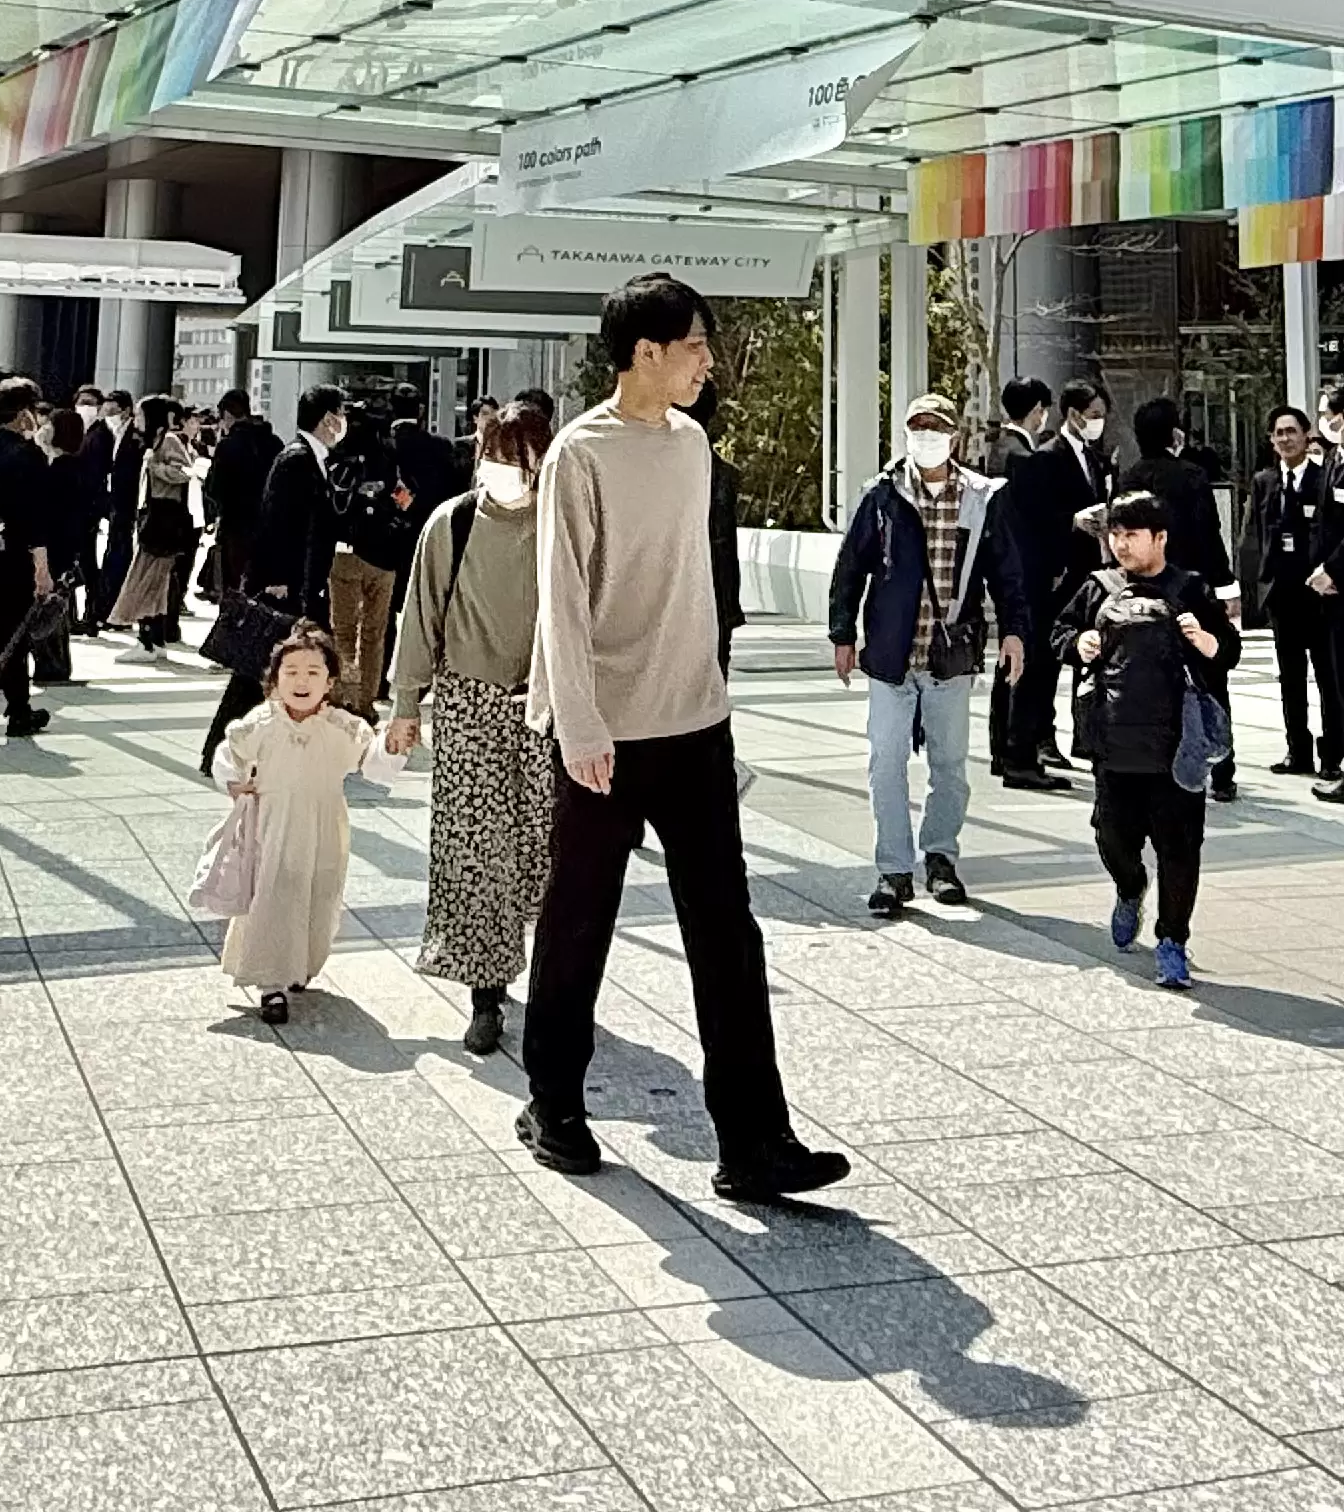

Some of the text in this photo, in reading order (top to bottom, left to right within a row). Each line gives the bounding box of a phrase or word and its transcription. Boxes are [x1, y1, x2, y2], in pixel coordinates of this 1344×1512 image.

[808, 74, 867, 108] 100色
[518, 135, 602, 171] 100 colors path
[550, 248, 772, 269] TAKANAWA GATEWAY CITY
[1316, 339, 1339, 352] HE
